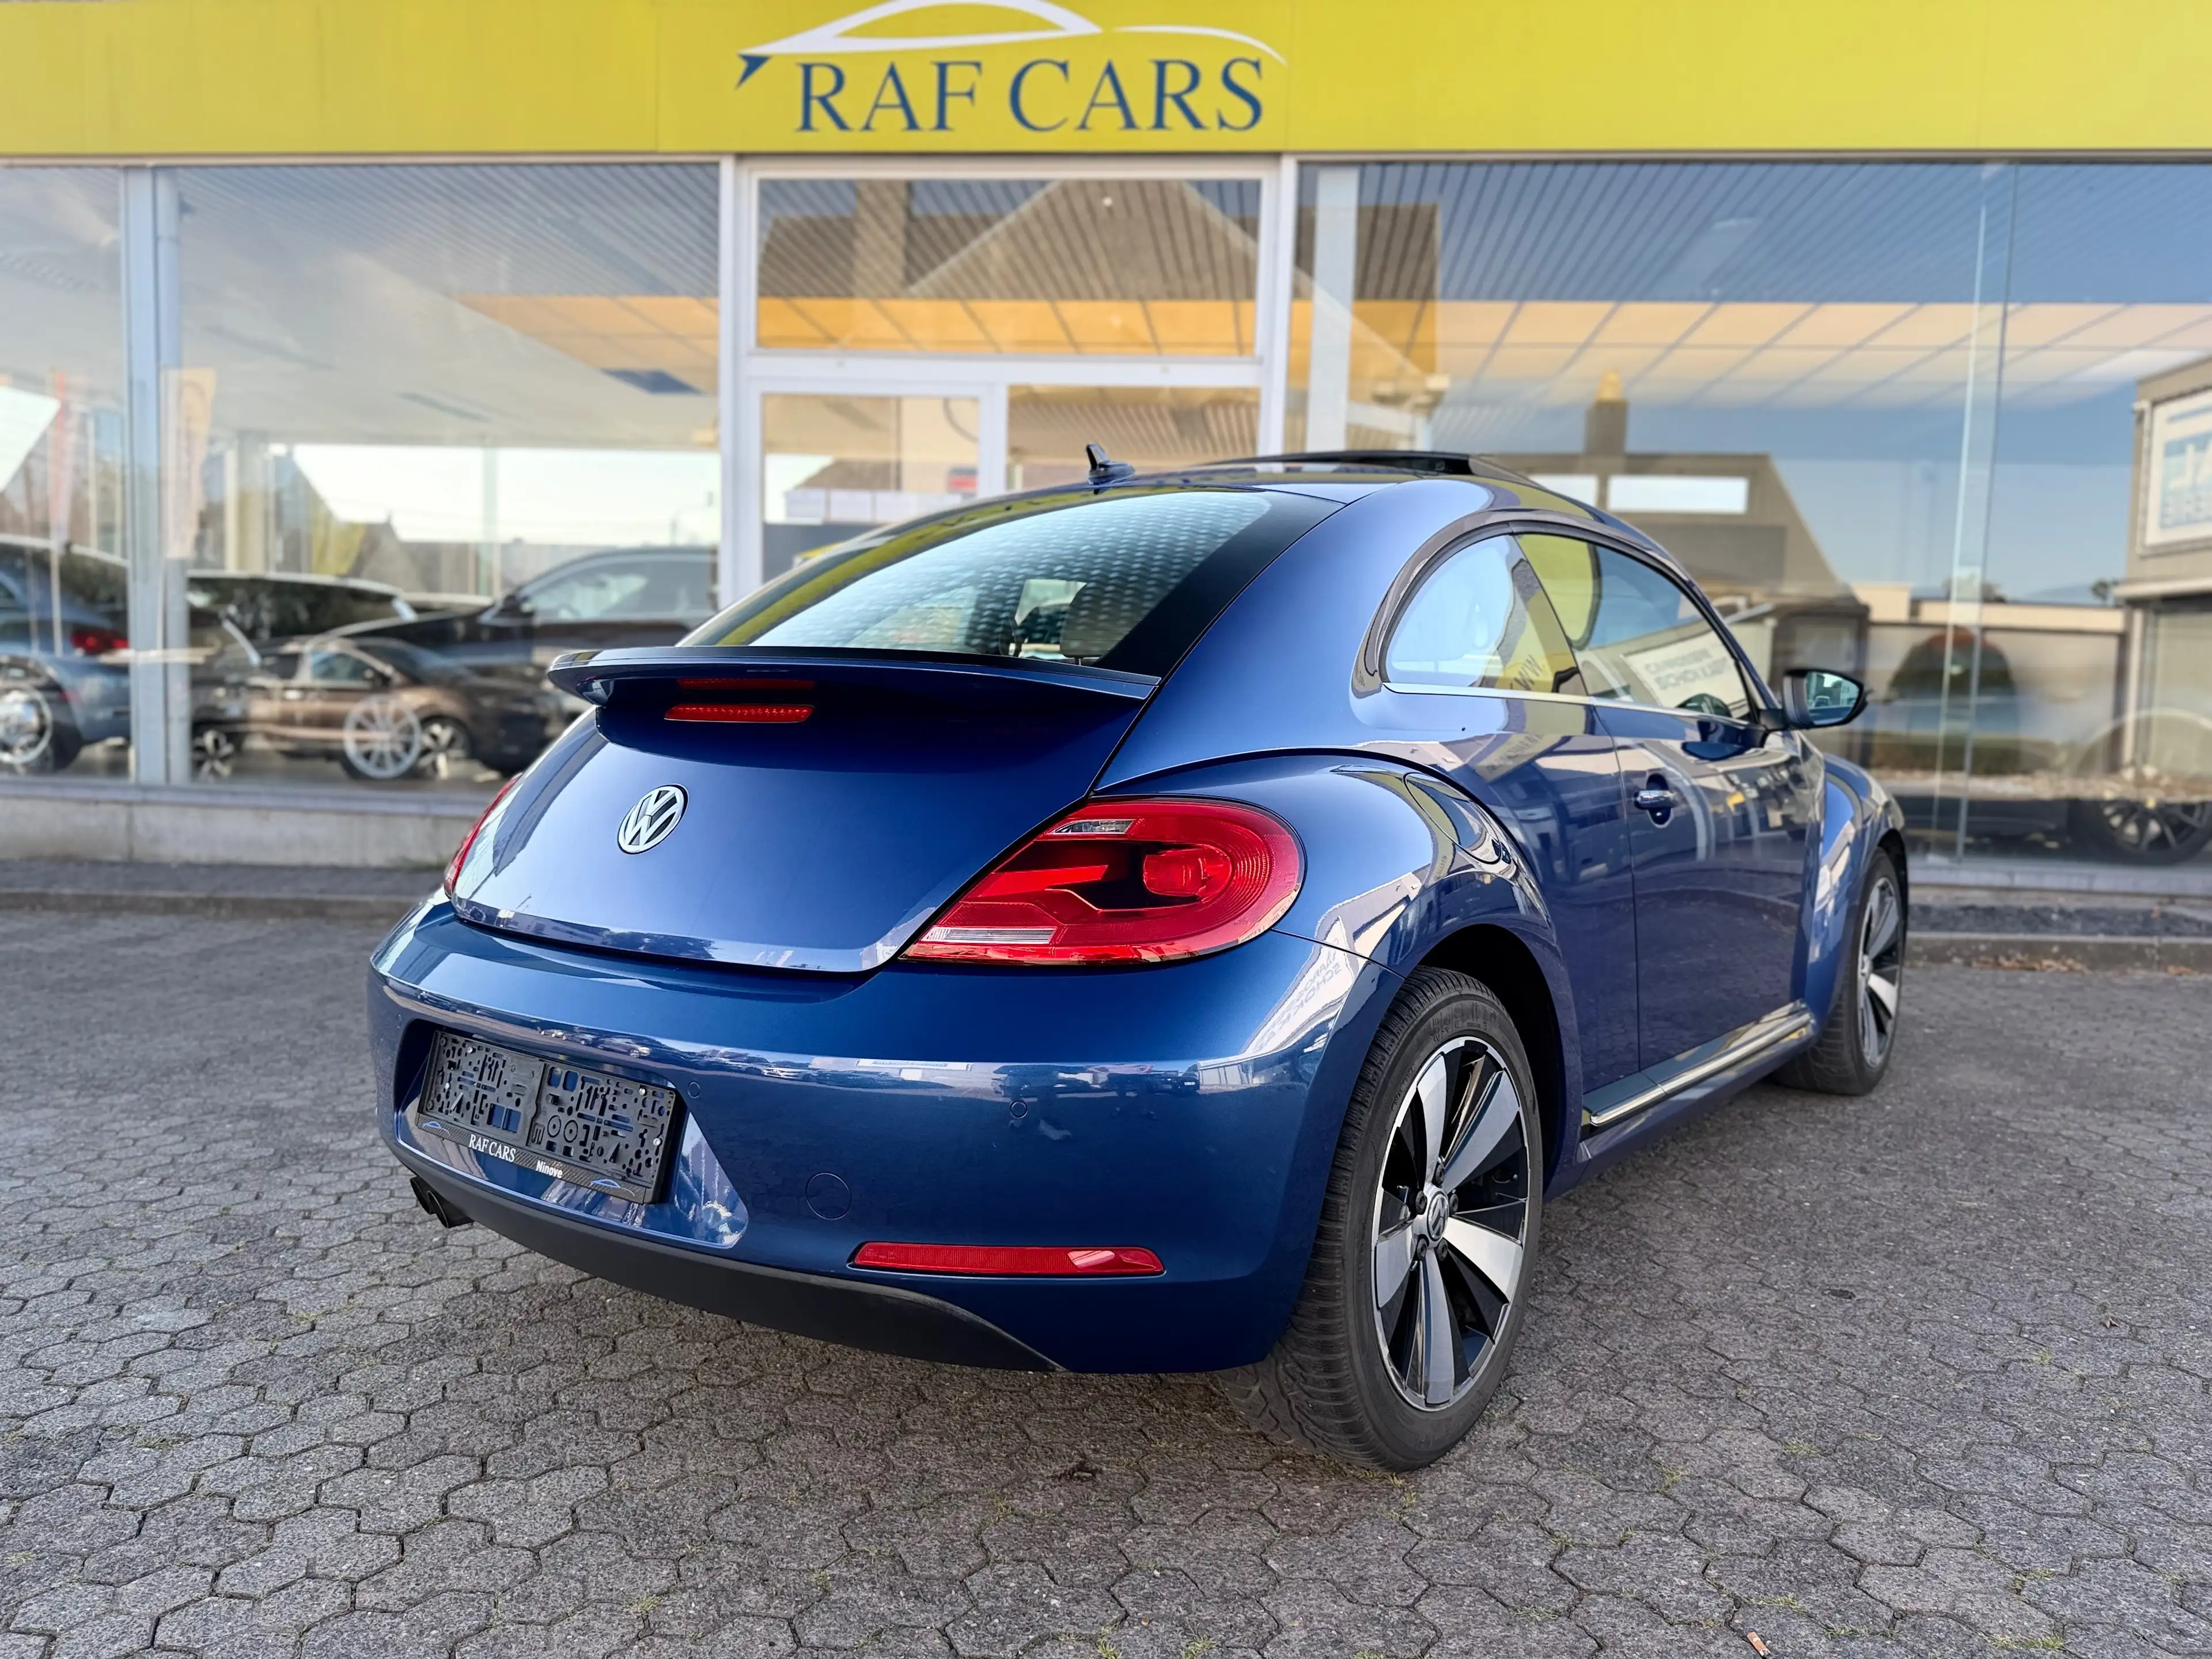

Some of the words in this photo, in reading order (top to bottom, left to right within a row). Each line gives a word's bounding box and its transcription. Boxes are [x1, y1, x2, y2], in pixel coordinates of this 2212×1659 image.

[794, 60, 983, 132] RAF
[1009, 57, 1263, 132] CARS
[468, 1133, 489, 1153] RAF
[489, 1141, 516, 1162] CARS
[535, 1160, 563, 1179] Ninove
